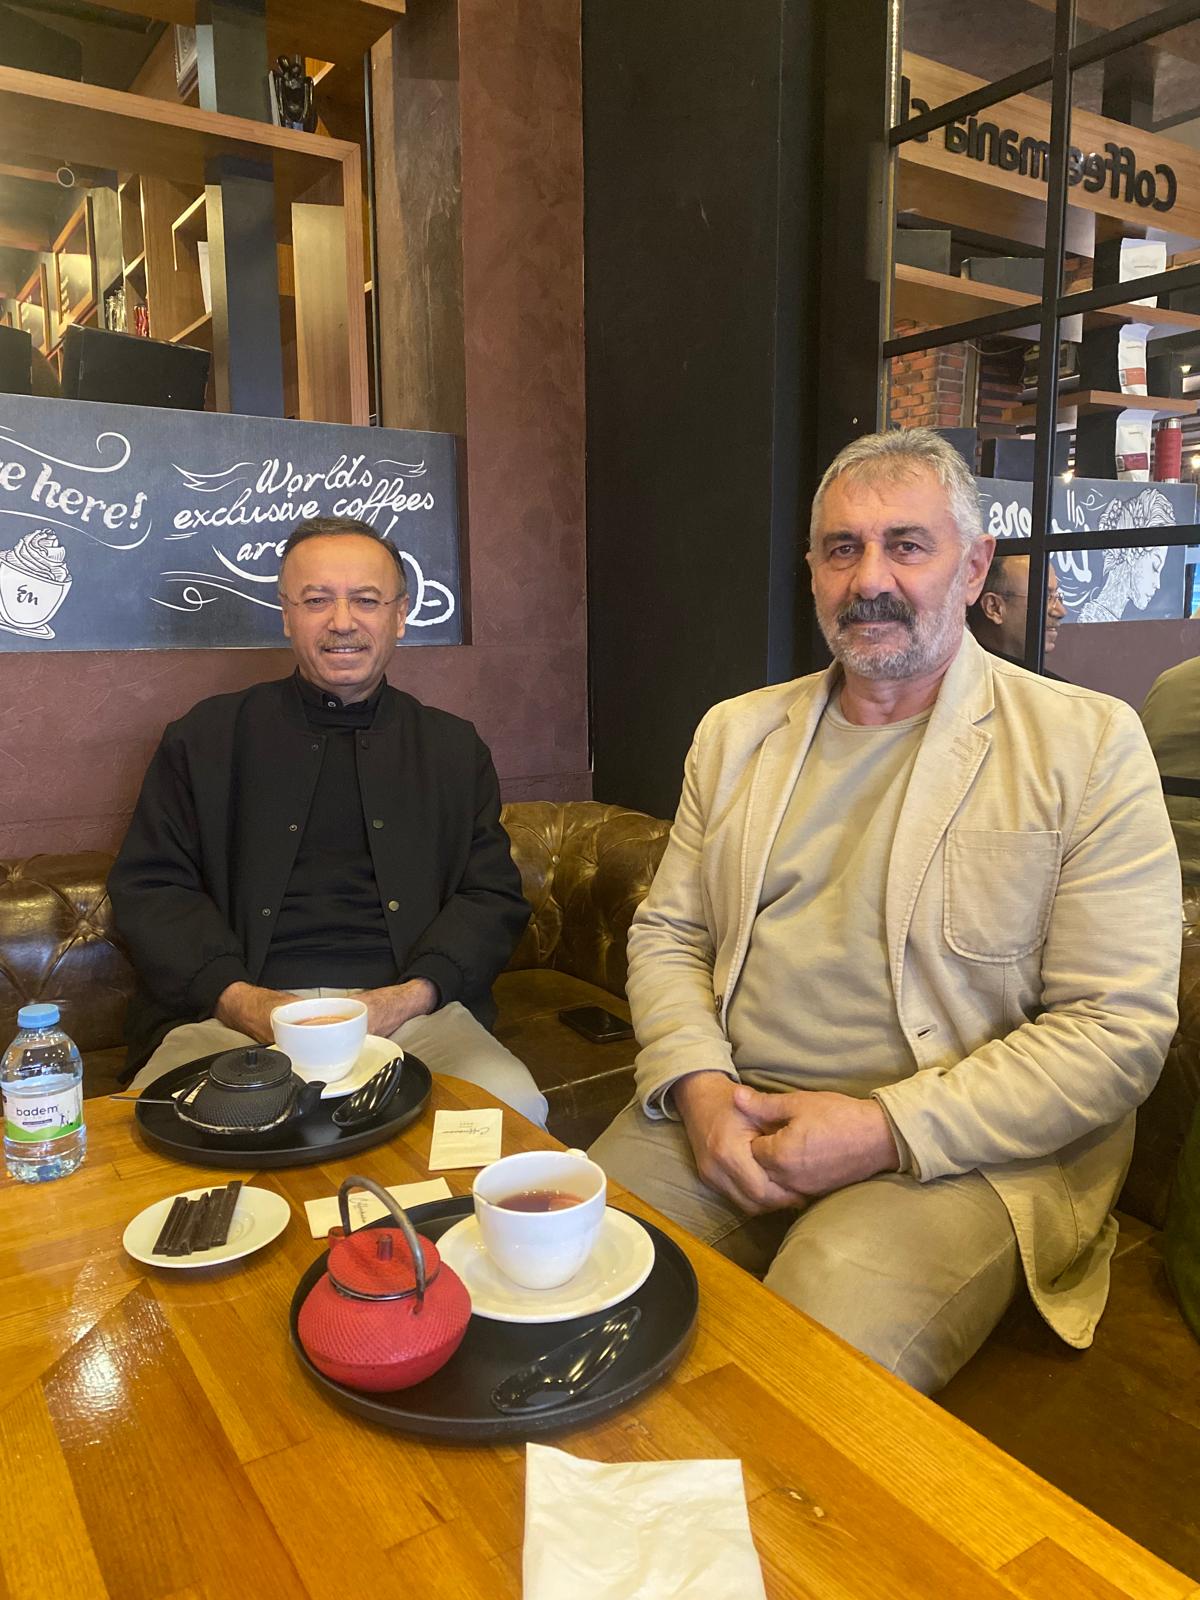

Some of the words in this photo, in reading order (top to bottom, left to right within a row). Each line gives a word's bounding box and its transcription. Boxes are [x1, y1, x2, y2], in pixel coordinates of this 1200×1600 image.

[31, 463, 148, 529] here!
[173, 487, 320, 530] exclusive
[332, 477, 435, 528] coffees
[16, 1105, 58, 1116] badem
